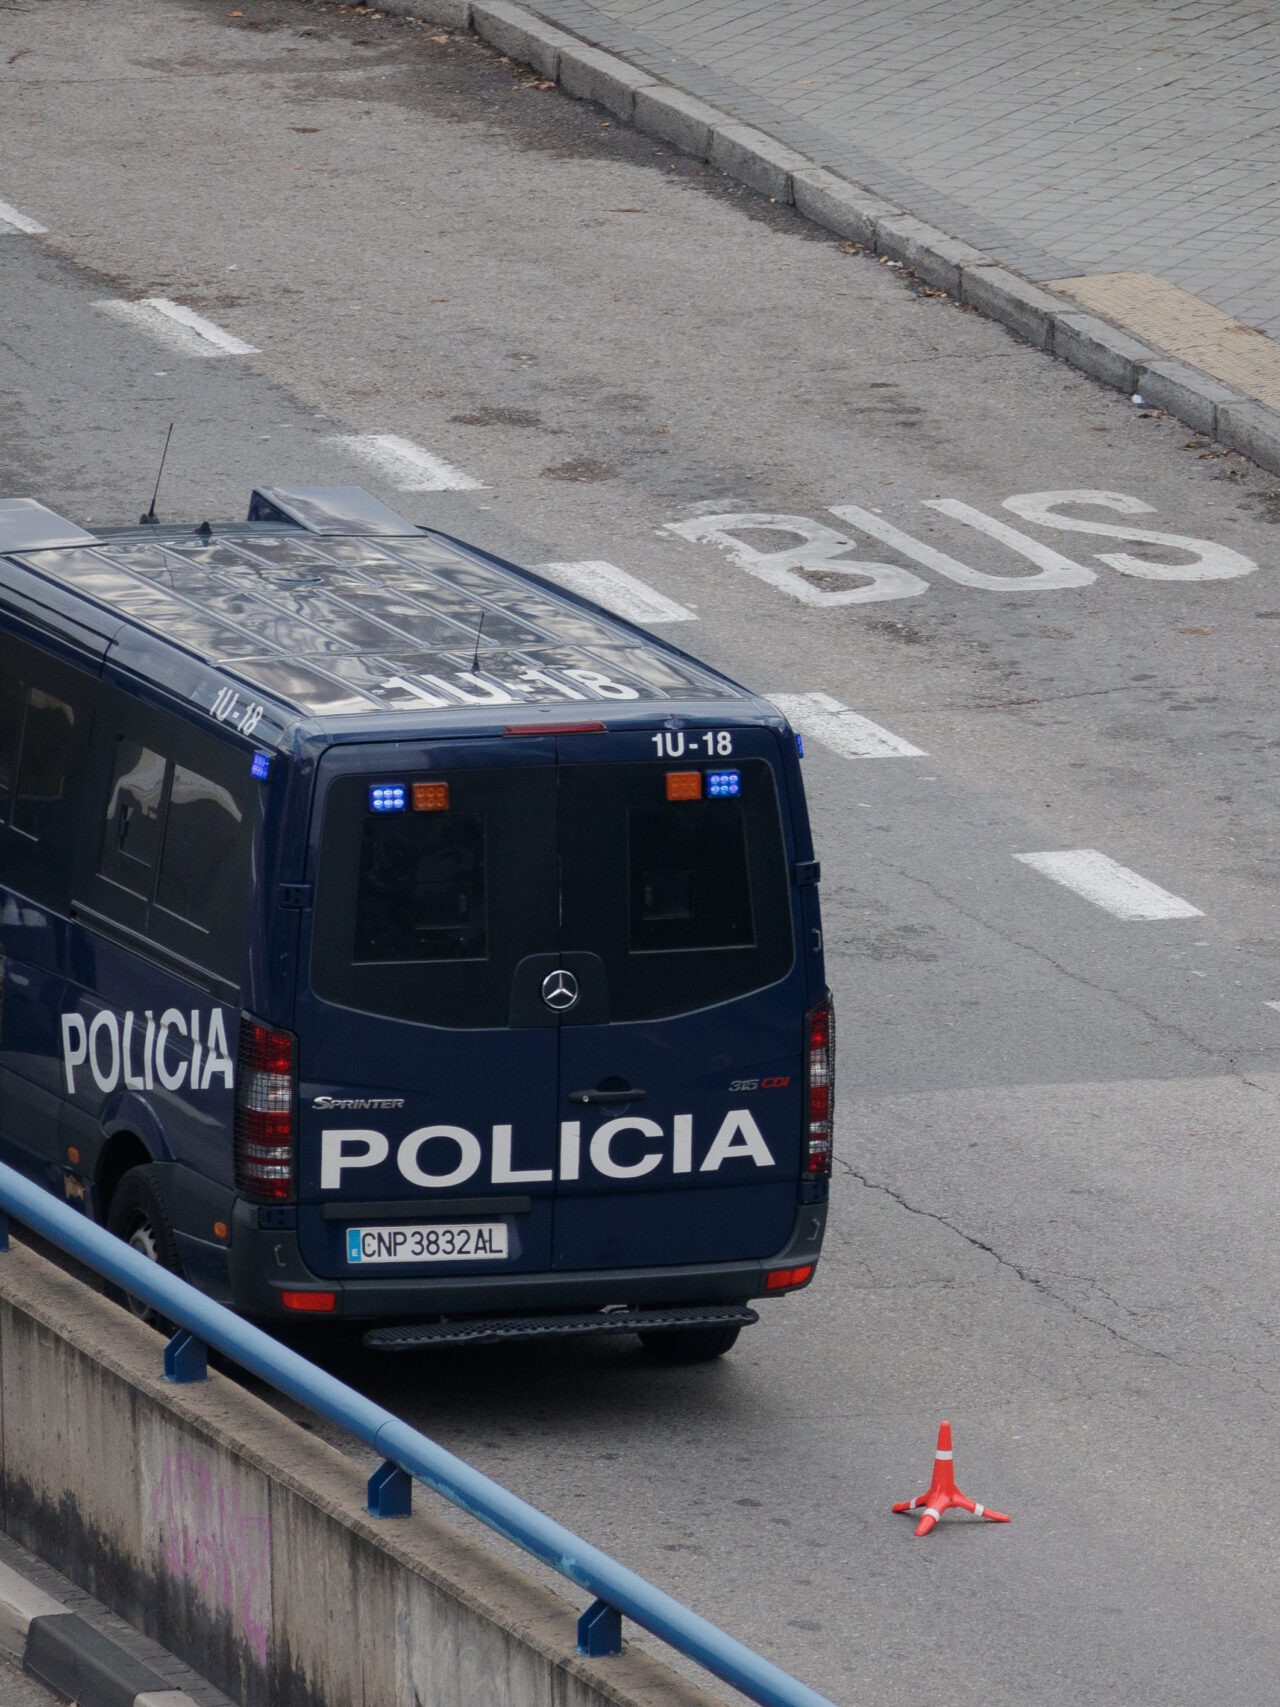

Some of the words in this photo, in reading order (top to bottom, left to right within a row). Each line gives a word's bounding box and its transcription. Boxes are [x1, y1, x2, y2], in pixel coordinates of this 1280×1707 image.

[661, 490, 1260, 606] BUS
[61, 1008, 234, 1094] POLICIA
[760, 1076, 790, 1089] CDI
[320, 1109, 776, 1190] POLICIA
